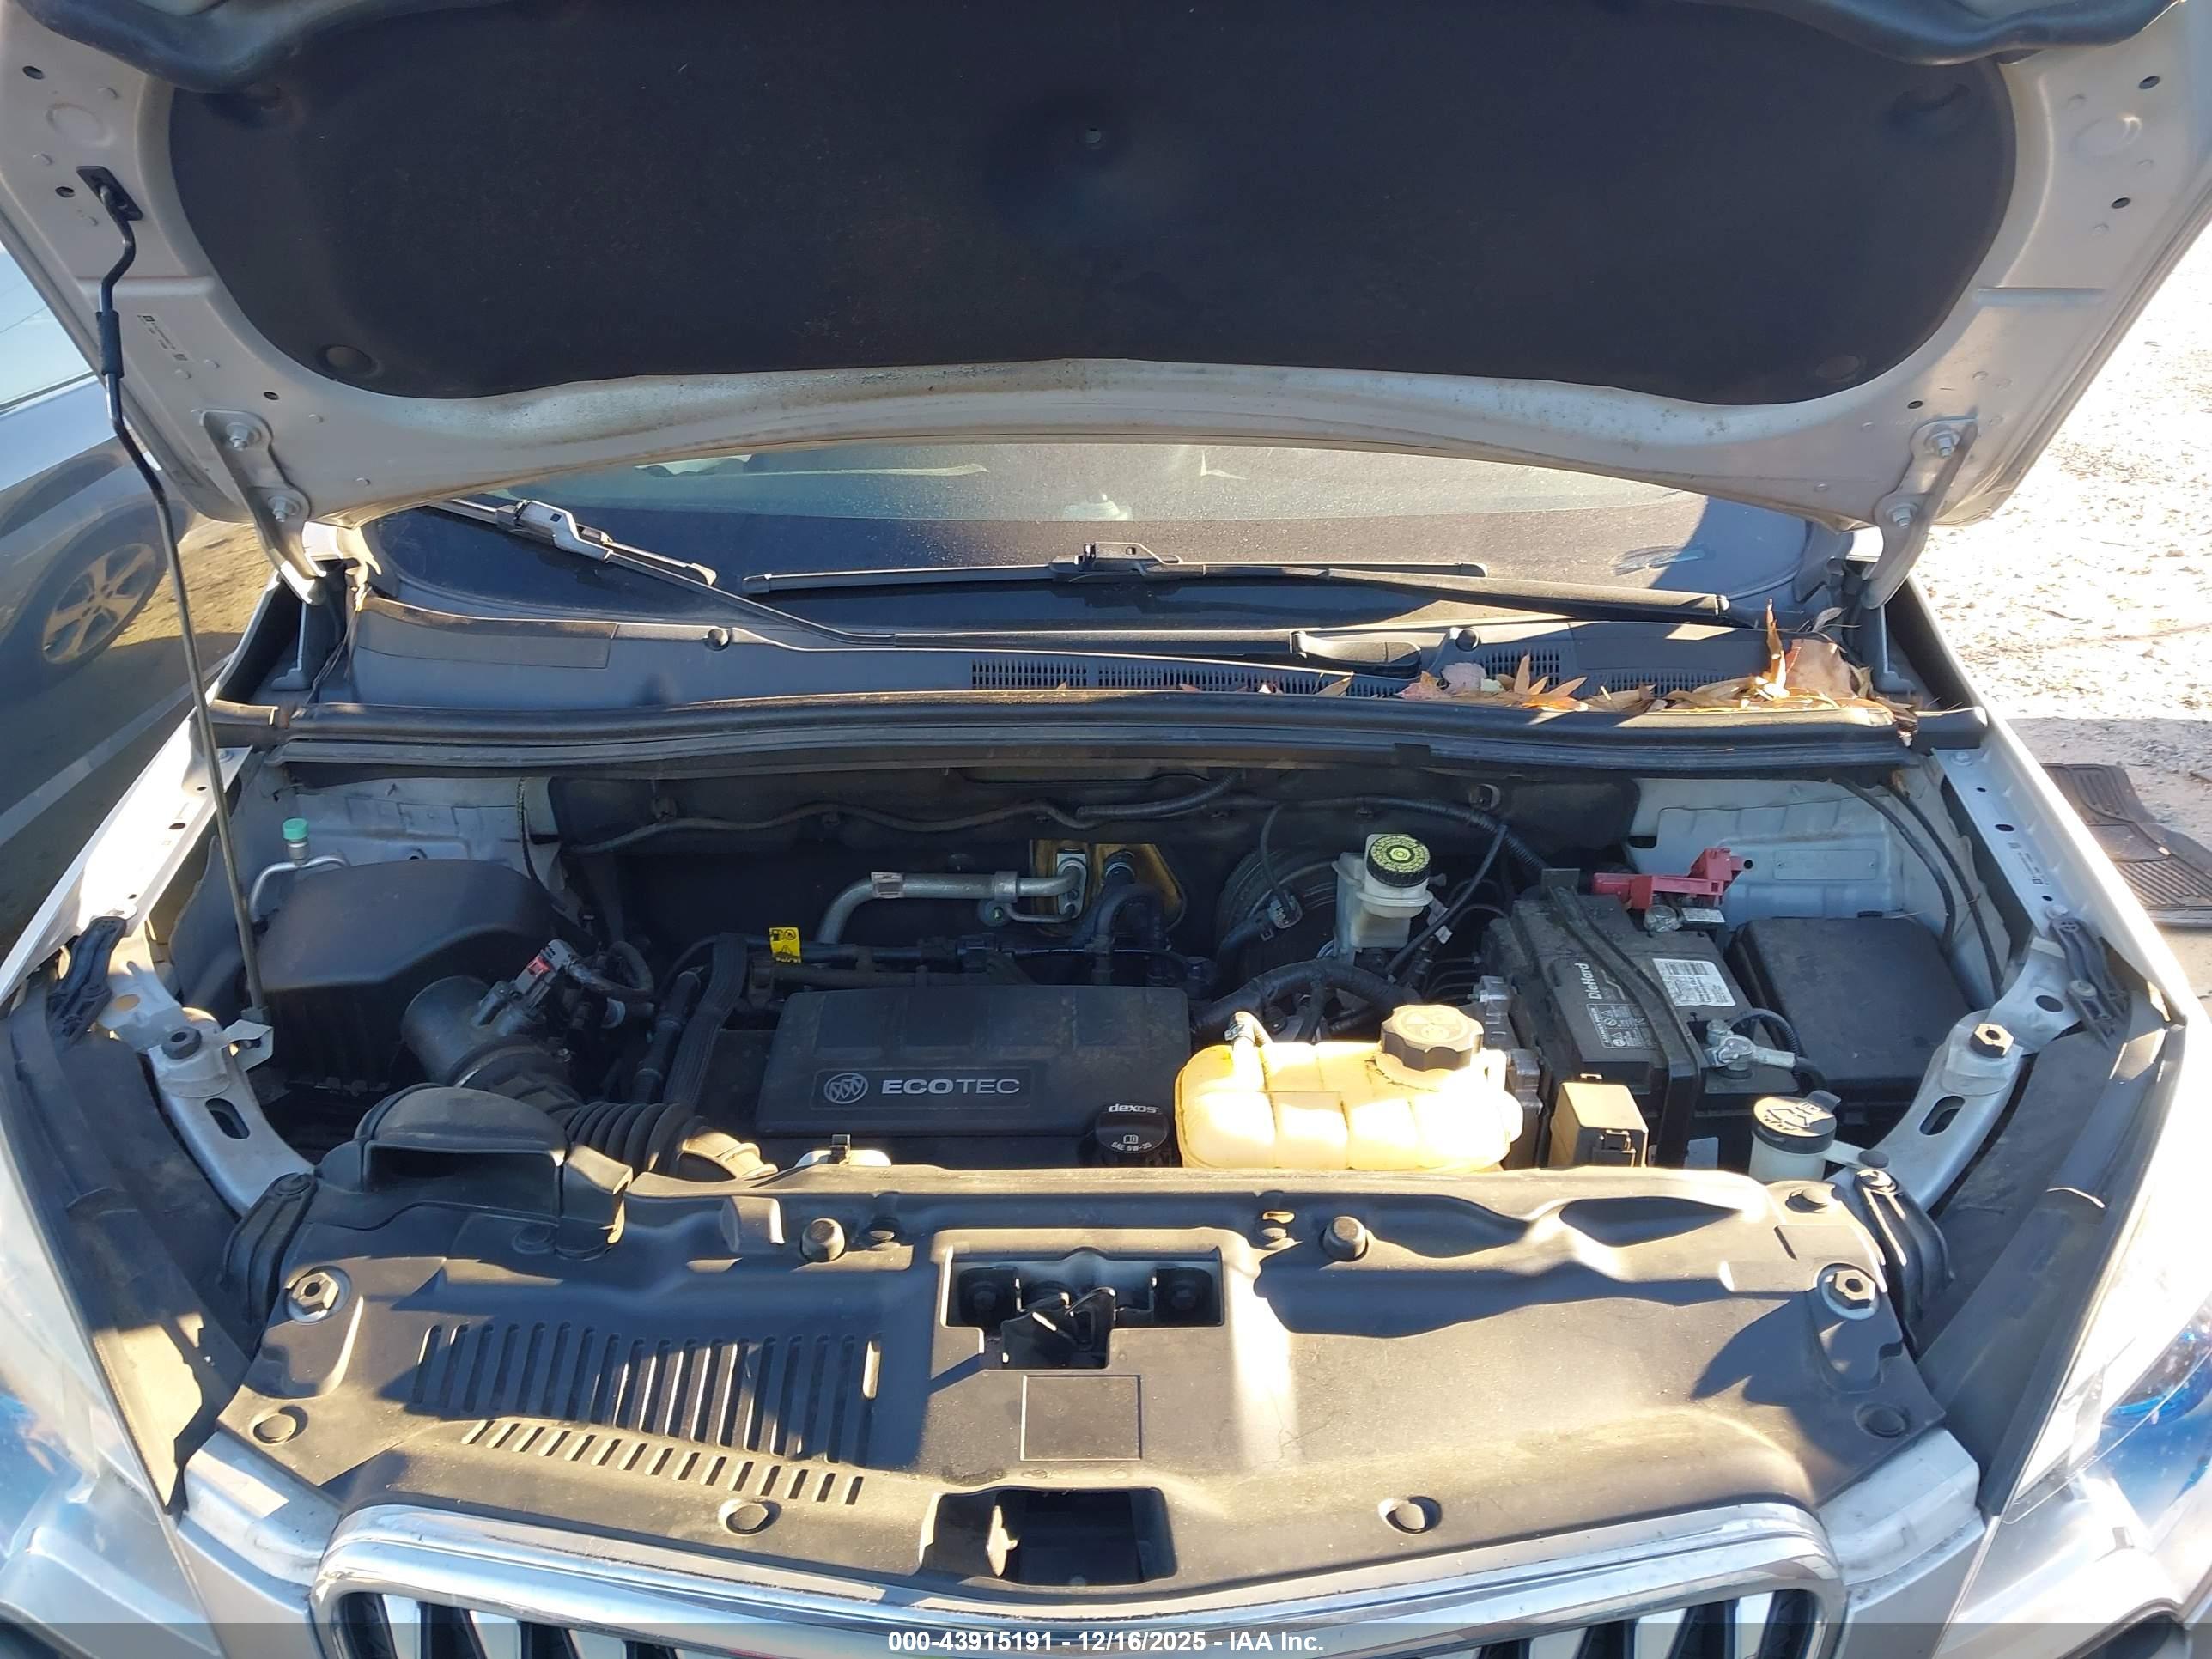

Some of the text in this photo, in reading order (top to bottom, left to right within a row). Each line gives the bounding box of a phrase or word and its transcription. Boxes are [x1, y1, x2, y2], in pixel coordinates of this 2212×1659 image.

[1574, 963, 1603, 1000] DieHard
[881, 1079, 1020, 1095] ECOTEC
[1108, 1103, 1159, 1114] dexos
[1110, 1141, 1126, 1151] SAE
